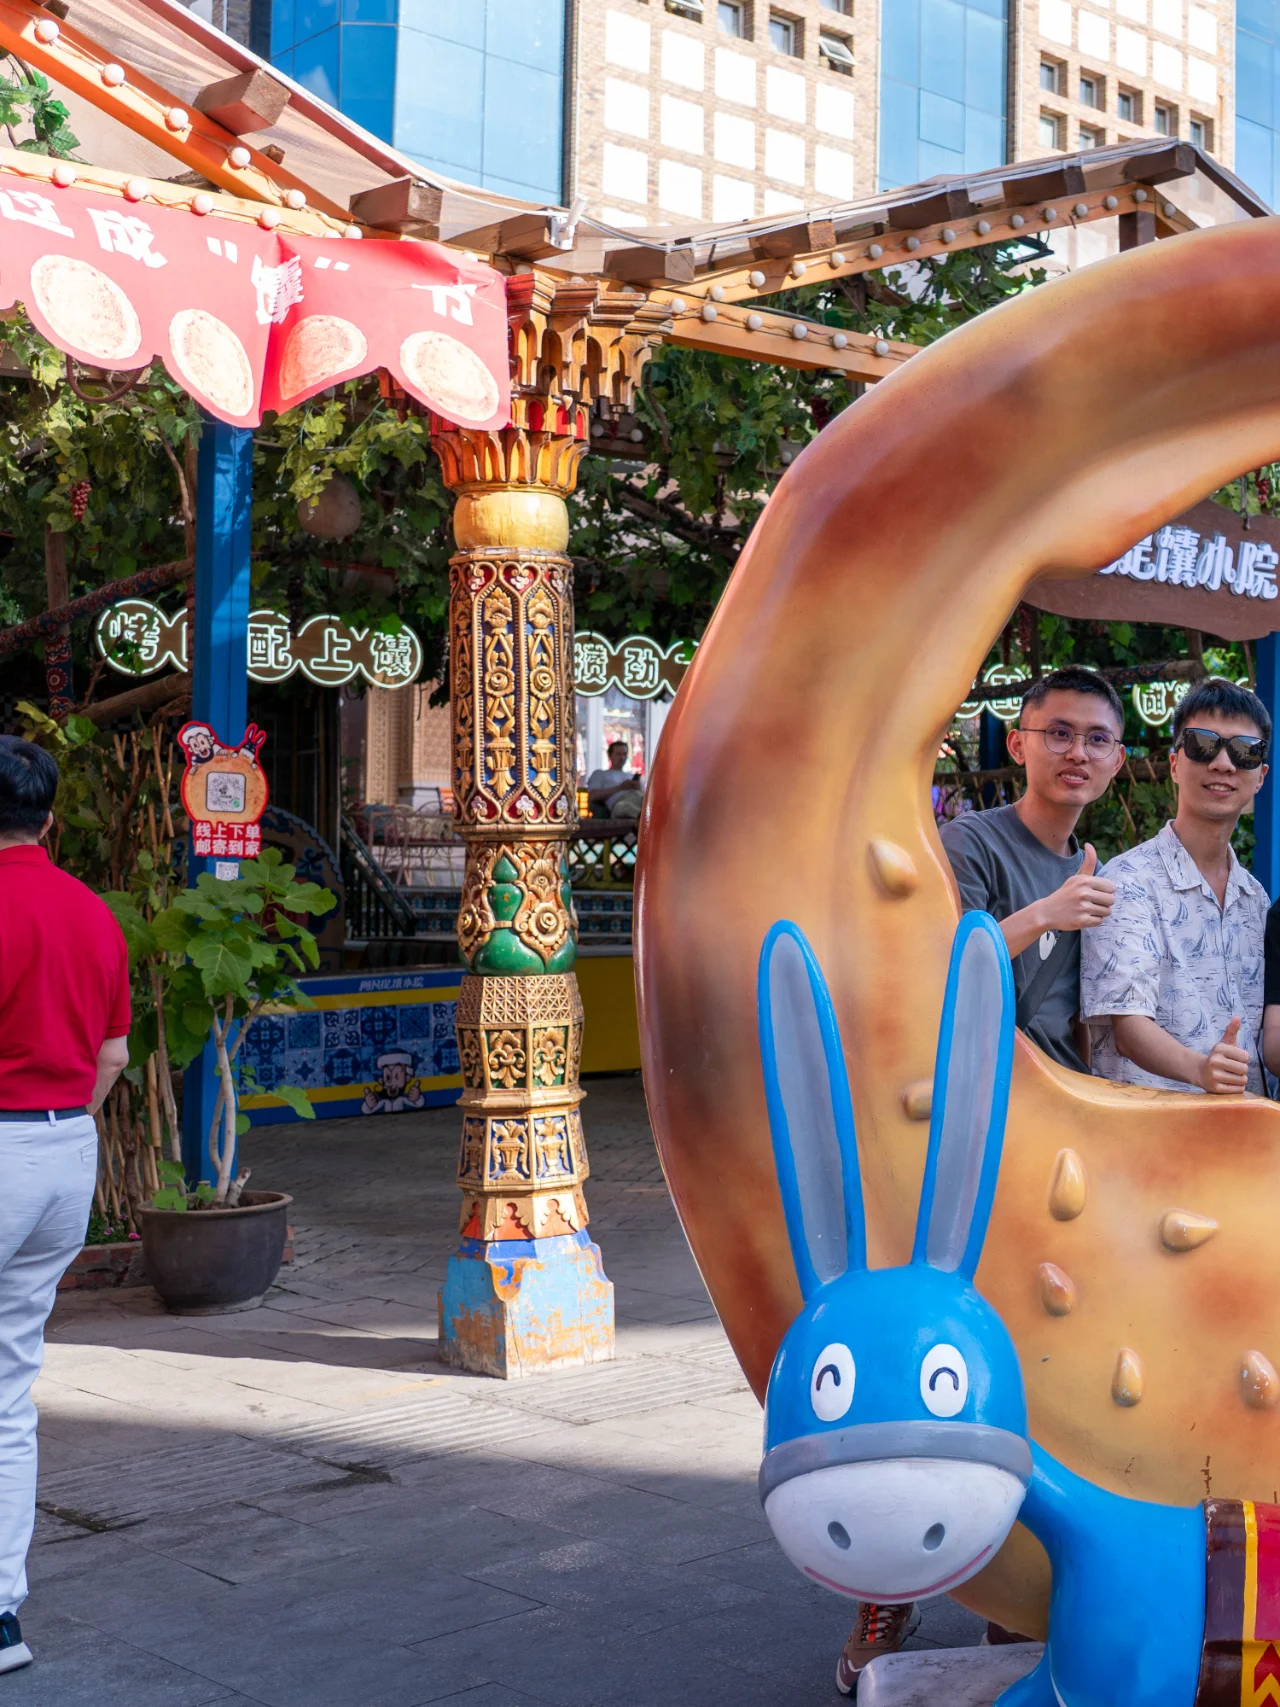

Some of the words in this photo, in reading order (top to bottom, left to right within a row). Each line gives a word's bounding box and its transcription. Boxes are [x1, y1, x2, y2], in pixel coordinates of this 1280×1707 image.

[196, 822, 261, 840] 线上下单
[195, 838, 261, 856] 邮寄到家
